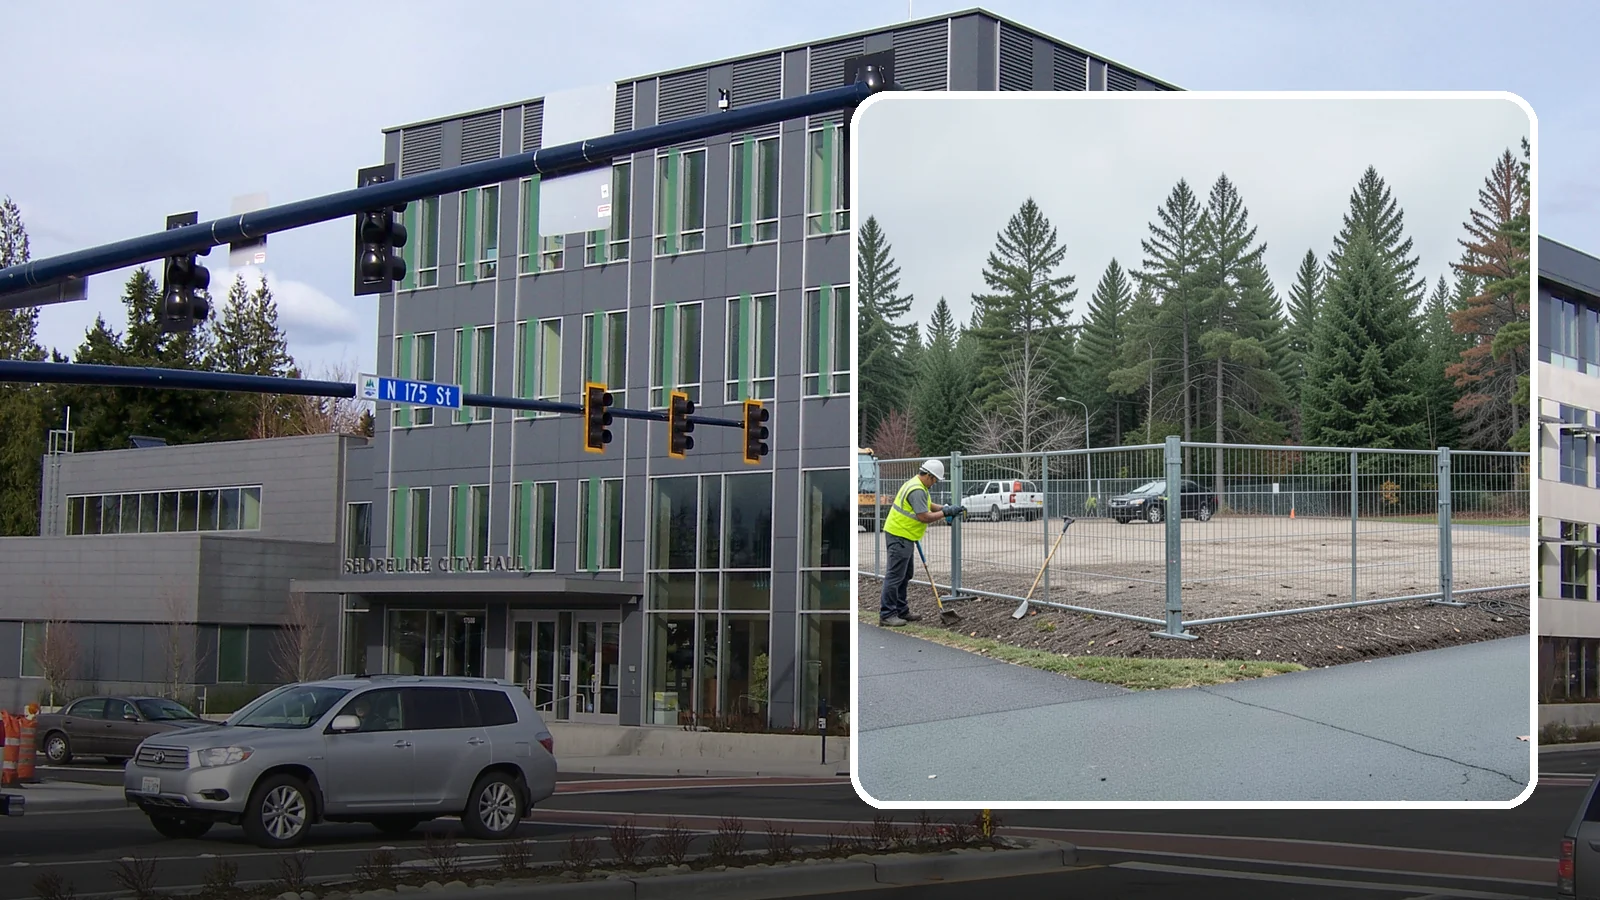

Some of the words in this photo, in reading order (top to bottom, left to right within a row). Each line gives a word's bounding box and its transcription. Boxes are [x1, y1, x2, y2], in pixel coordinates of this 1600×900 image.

[387, 381, 396, 400] N
[405, 383, 427, 403] 175
[436, 387, 451, 406] St
[343, 557, 432, 574] SHORELINE
[438, 556, 475, 572] CITY
[483, 555, 526, 572] HALL
